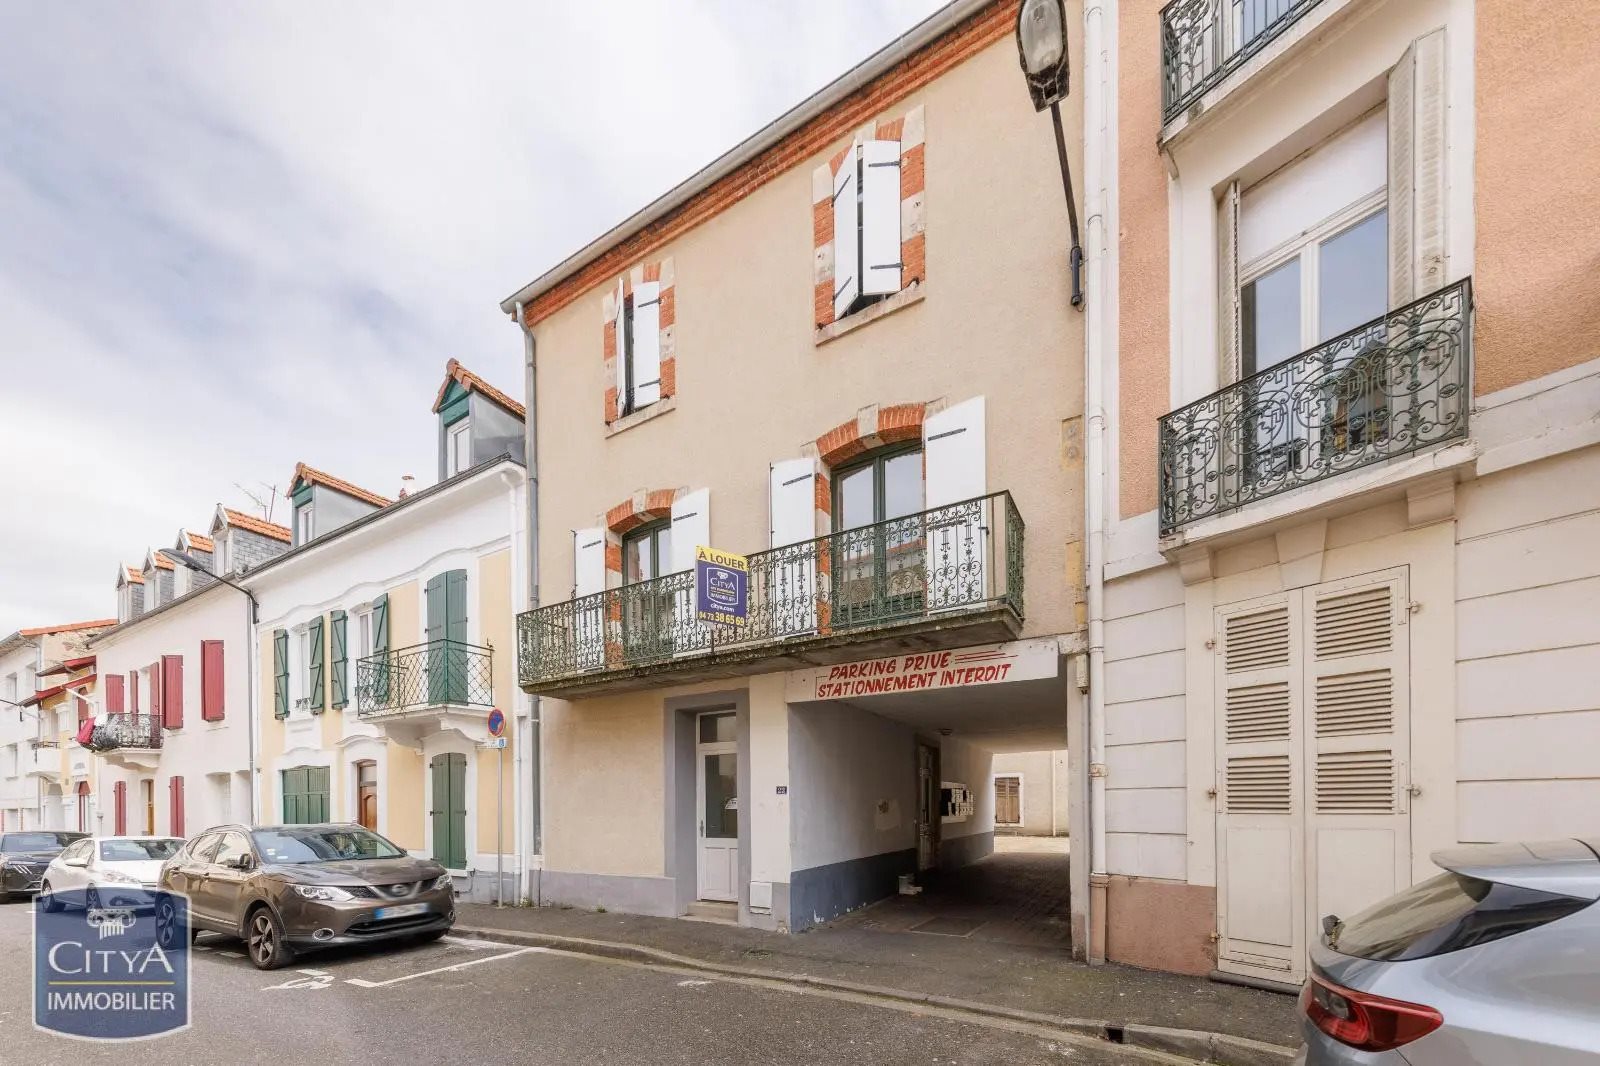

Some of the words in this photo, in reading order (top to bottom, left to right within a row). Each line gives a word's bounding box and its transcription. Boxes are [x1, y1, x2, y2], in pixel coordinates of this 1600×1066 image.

[710, 552, 744, 568] LOUER
[710, 603, 735, 613] citya.com
[707, 612, 714, 621] 73
[715, 612, 725, 622] 38
[725, 614, 735, 624] 65
[735, 616, 745, 626] 69
[829, 659, 897, 680] PARKING
[818, 671, 938, 698] STATIONNEMENT
[940, 663, 1012, 685] INTERDIT
